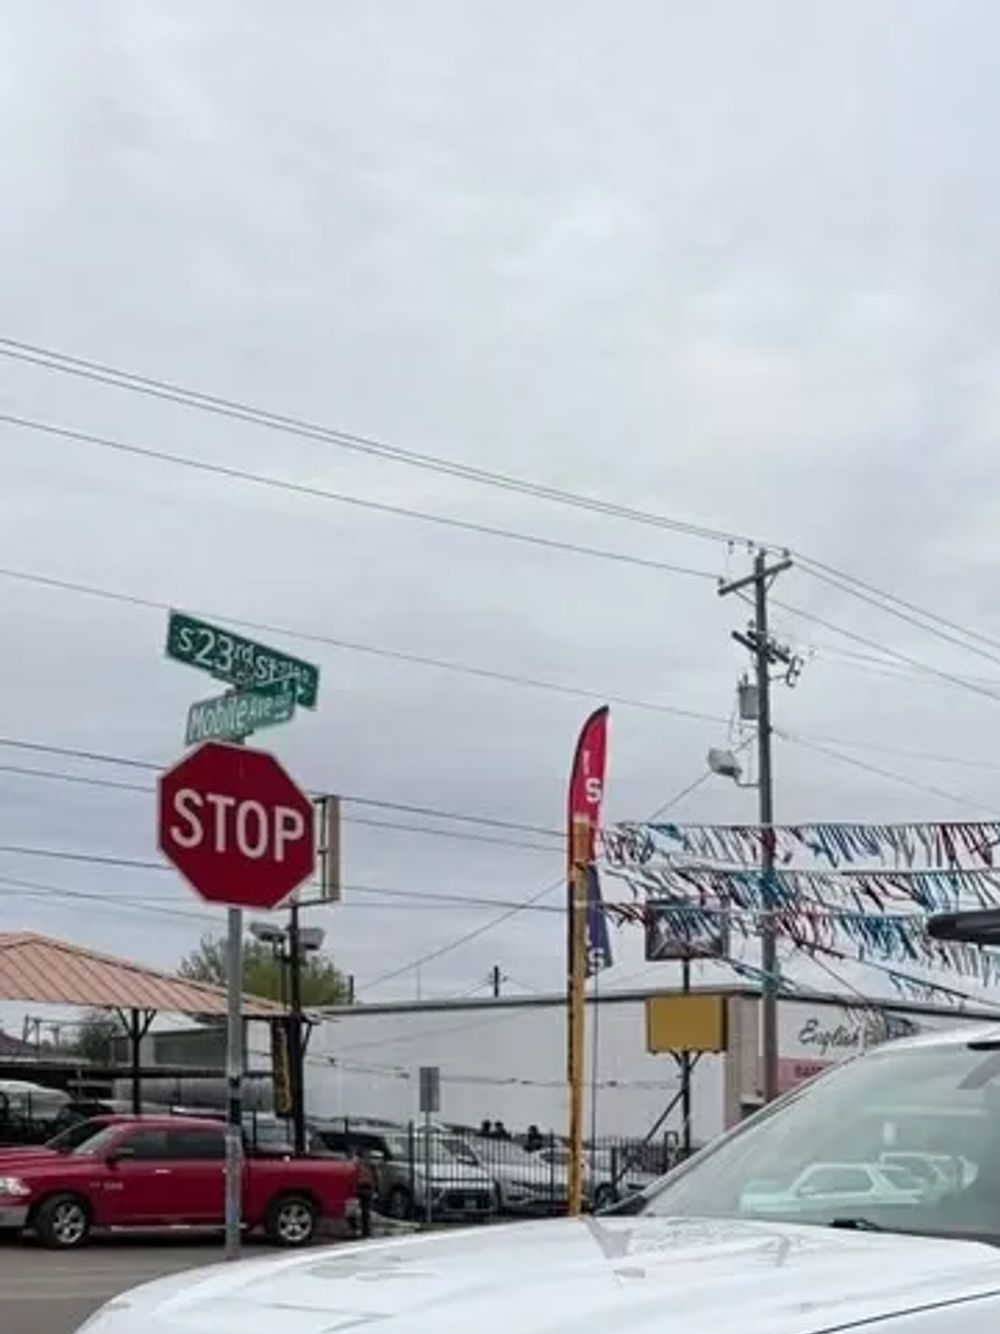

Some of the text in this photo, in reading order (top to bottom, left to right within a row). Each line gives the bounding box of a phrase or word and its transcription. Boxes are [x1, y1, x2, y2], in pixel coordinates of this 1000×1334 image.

[178, 627, 194, 652] S
[194, 628, 255, 671] 23rd
[170, 787, 304, 863] STOP
